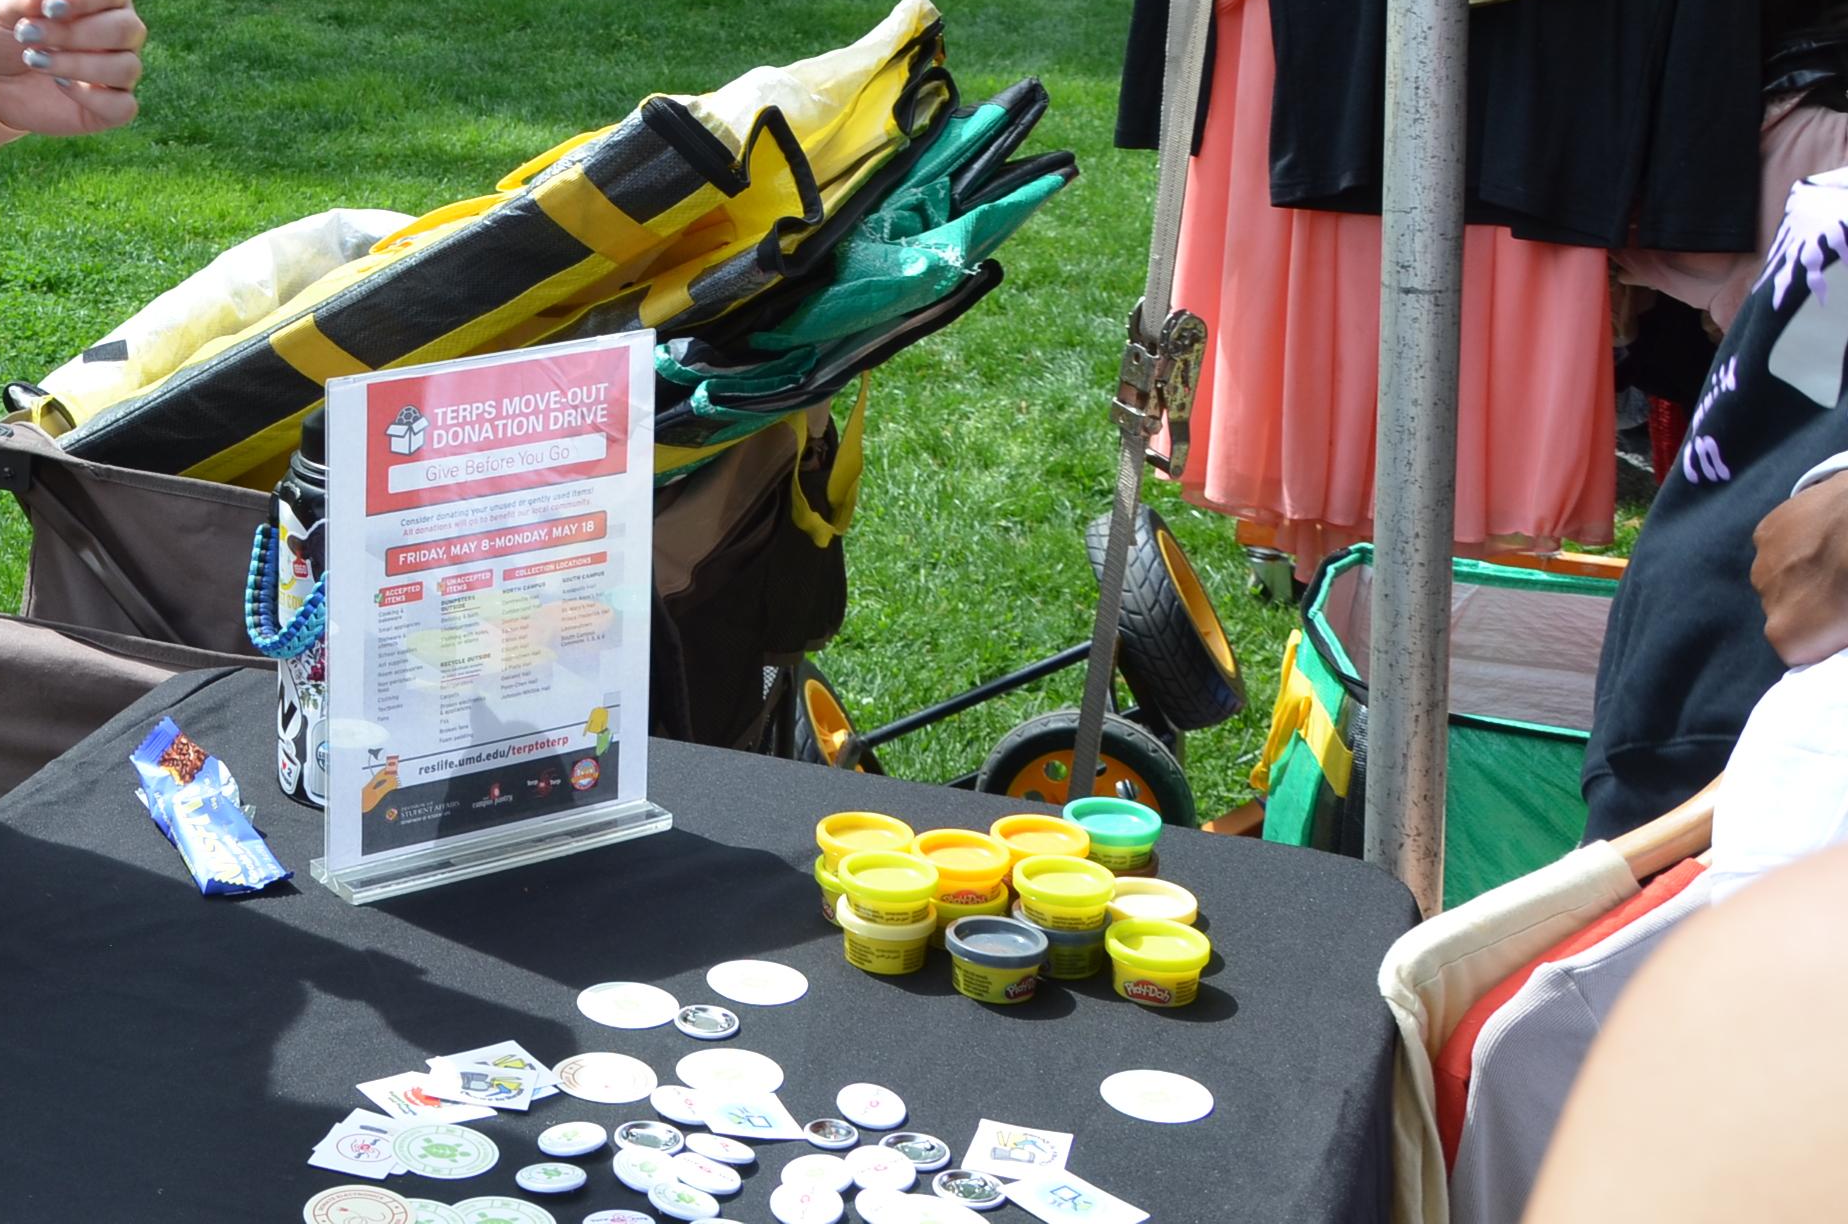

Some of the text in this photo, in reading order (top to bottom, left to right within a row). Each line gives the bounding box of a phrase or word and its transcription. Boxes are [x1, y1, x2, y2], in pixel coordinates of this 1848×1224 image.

[434, 383, 609, 426] TERPS MOVE-OUT
[432, 404, 608, 449] DONATION DRIVE
[425, 445, 570, 482] Give Before You Go
[400, 513, 434, 527] Consider
[436, 508, 469, 522] donating
[471, 505, 488, 517] your
[489, 500, 516, 513] unused
[517, 499, 527, 507] or
[527, 493, 551, 506] gently
[553, 491, 570, 502] used
[402, 528, 414, 537] All
[415, 522, 453, 535] donations
[454, 519, 467, 528] will
[468, 518, 480, 528] go
[480, 516, 489, 524] to
[489, 509, 516, 522] benefit
[517, 508, 530, 517] our
[531, 503, 549, 514] local
[399, 520, 594, 566] FRIDAY, MAY 8-MONDAY, MAY 18
[515, 556, 592, 577] COLLECTION LOCATIONS
[582, 570, 605, 580] CAMPUS
[446, 572, 491, 586] UNACCEPTED
[446, 584, 467, 593] ITEMS
[523, 581, 546, 591] CAMPUS
[385, 584, 421, 596] ACCEPTED
[385, 595, 406, 604] ITEMS
[440, 652, 491, 667] RECYCLE OUTSIDE
[418, 734, 569, 776] reslife.umd.edu/terptoterp
[400, 806, 430, 819] STUDENT
[430, 799, 461, 813] AFFAIRS
[1124, 982, 1170, 1003] Play-Doh
